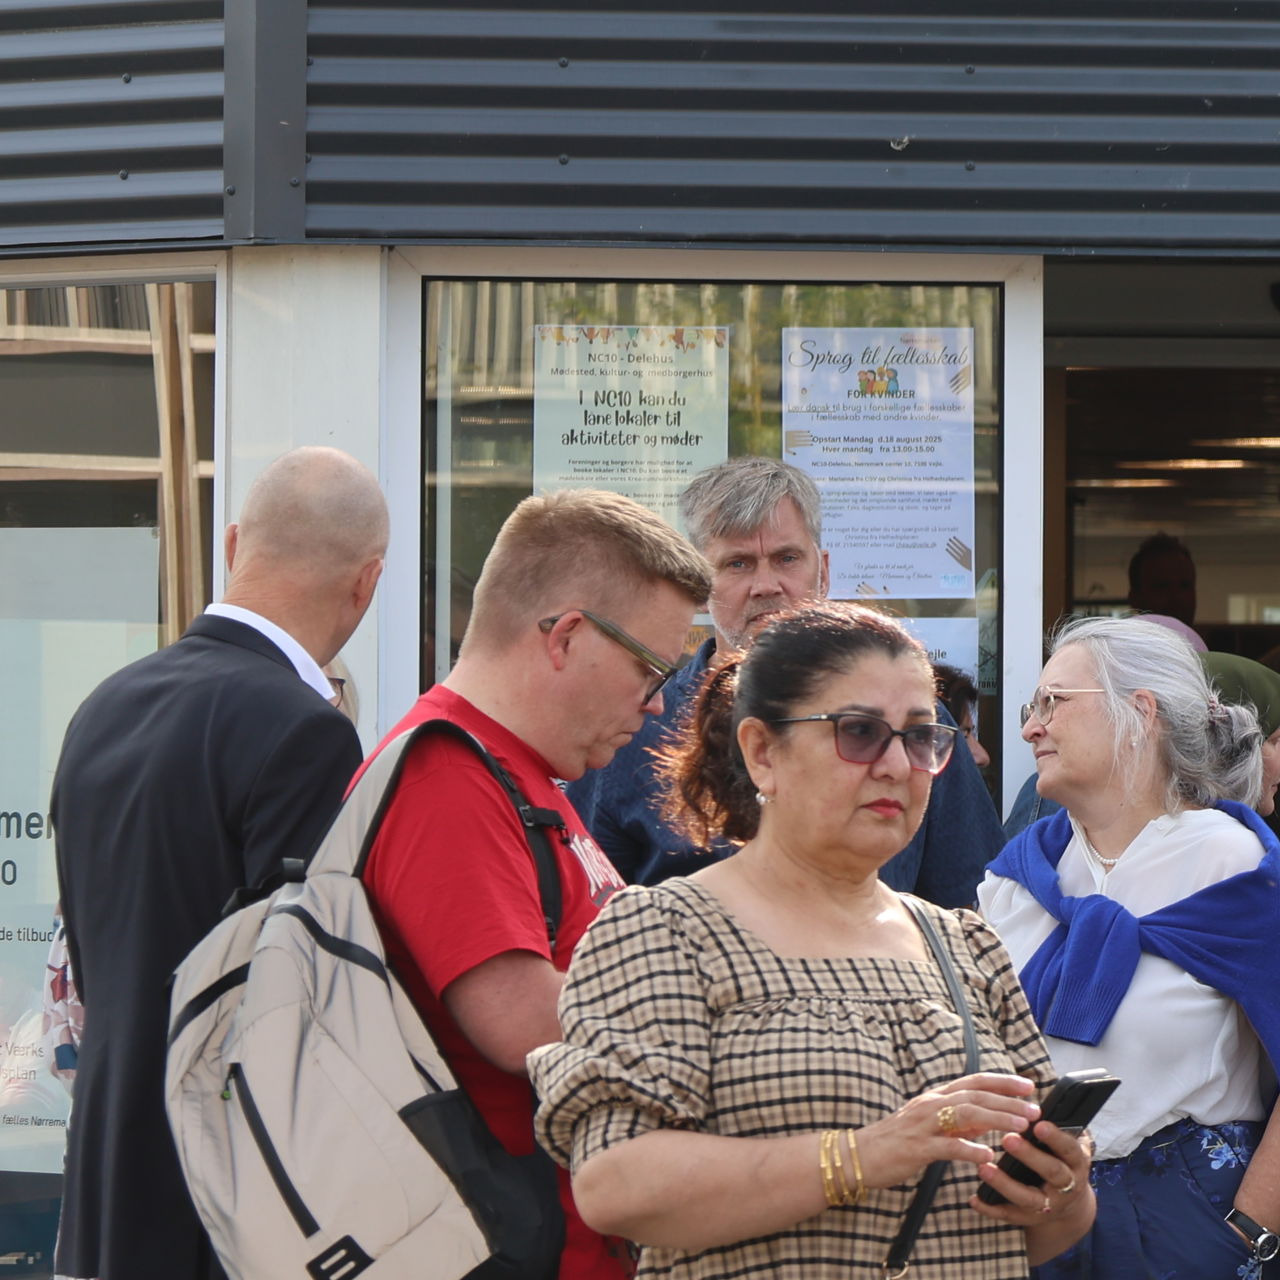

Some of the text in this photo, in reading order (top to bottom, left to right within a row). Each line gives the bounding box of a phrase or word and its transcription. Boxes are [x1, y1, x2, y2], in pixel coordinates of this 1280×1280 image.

[588, 353, 617, 364] NC10
[627, 353, 674, 364] Delehus
[788, 340, 968, 373] Sprog til fællesskab
[594, 390, 632, 407] NC10
[638, 390, 665, 407] kan
[668, 390, 686, 407] du
[847, 390, 915, 399] FOR KVINDER
[615, 410, 662, 426] lokaler
[666, 410, 680, 426] til
[862, 413, 881, 422] med
[884, 413, 908, 422] andre
[561, 429, 703, 447] aktiviteter og møder
[812, 436, 840, 444] Opstart
[843, 436, 874, 444] Mandag
[896, 436, 922, 444] august
[842, 446, 874, 454] mandag
[925, 649, 946, 660] ejle
[31, 1116, 66, 1127] Nørrema
